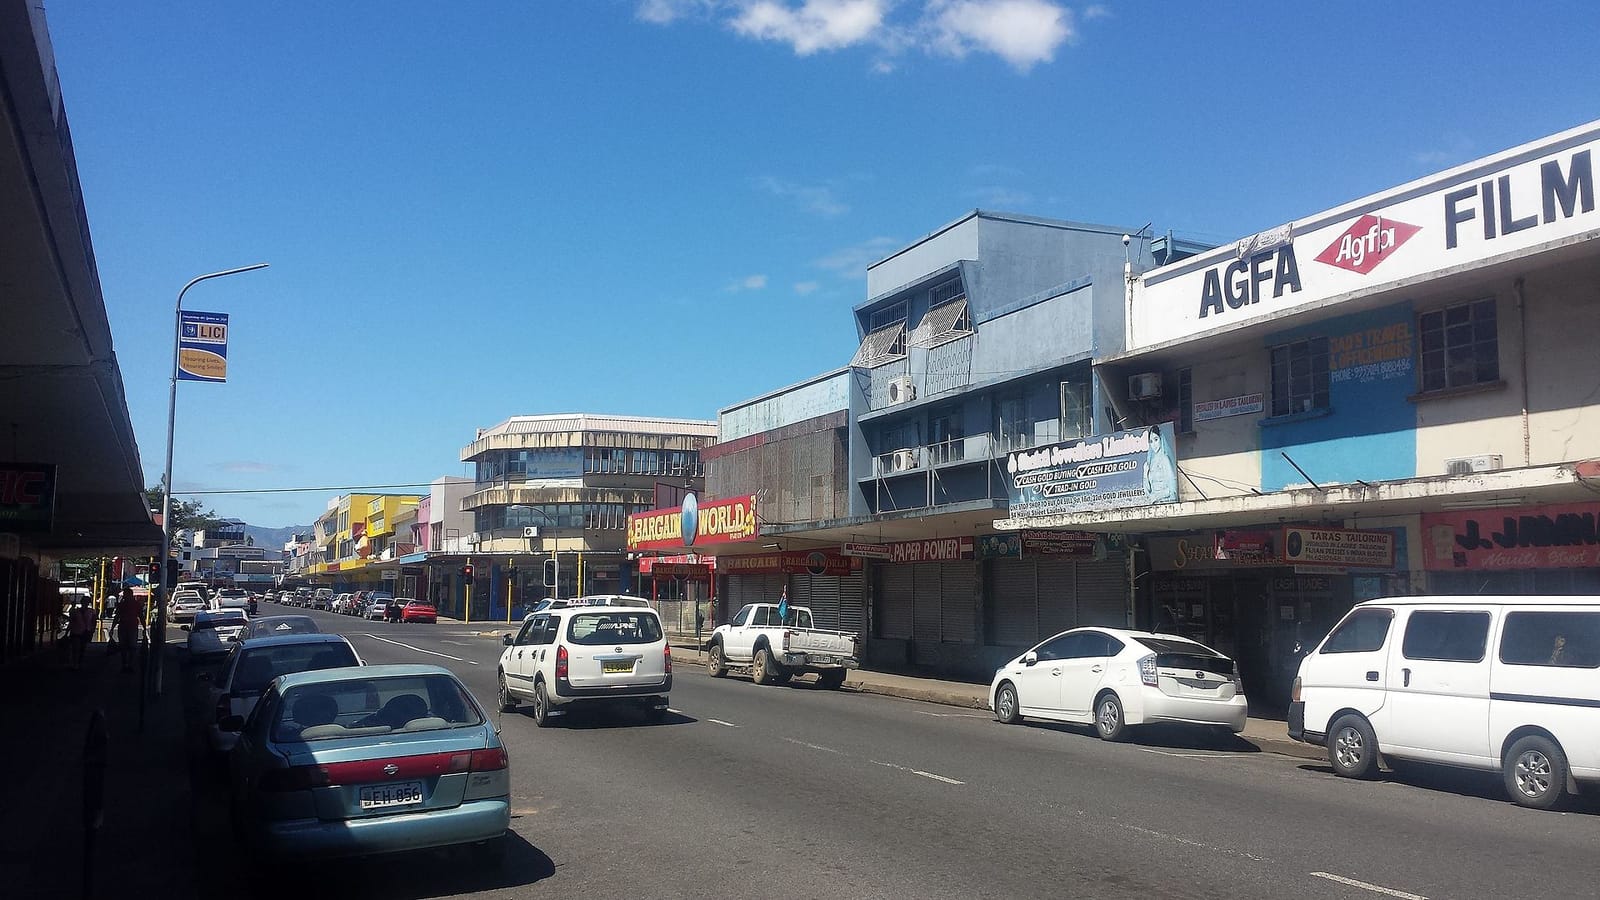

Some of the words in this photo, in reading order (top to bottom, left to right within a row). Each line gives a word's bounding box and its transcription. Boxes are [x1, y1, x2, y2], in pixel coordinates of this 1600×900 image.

[1444, 149, 1595, 250] FILM
[1336, 224, 1395, 266] Agfa
[1199, 245, 1303, 319] AGFA
[200, 326, 225, 338] LICI
[1087, 465, 1103, 475] CASH
[1104, 464, 1117, 473] FOR
[1118, 461, 1138, 471] GOLD
[1022, 476, 1037, 485] CASH
[1037, 474, 1053, 482] GOLD
[1079, 480, 1097, 490] GOLD
[1102, 492, 1117, 500] GOLD
[634, 512, 682, 543] BARGAIN
[698, 503, 745, 537] WORLD
[1310, 531, 1342, 541] TARAS
[1346, 533, 1388, 544] TAILORING
[893, 543, 921, 562] PAPER
[923, 539, 958, 561] POWER
[728, 557, 778, 570] BARGAIN
[570, 599, 588, 607] TAXI
[796, 636, 847, 650] NISSAN
